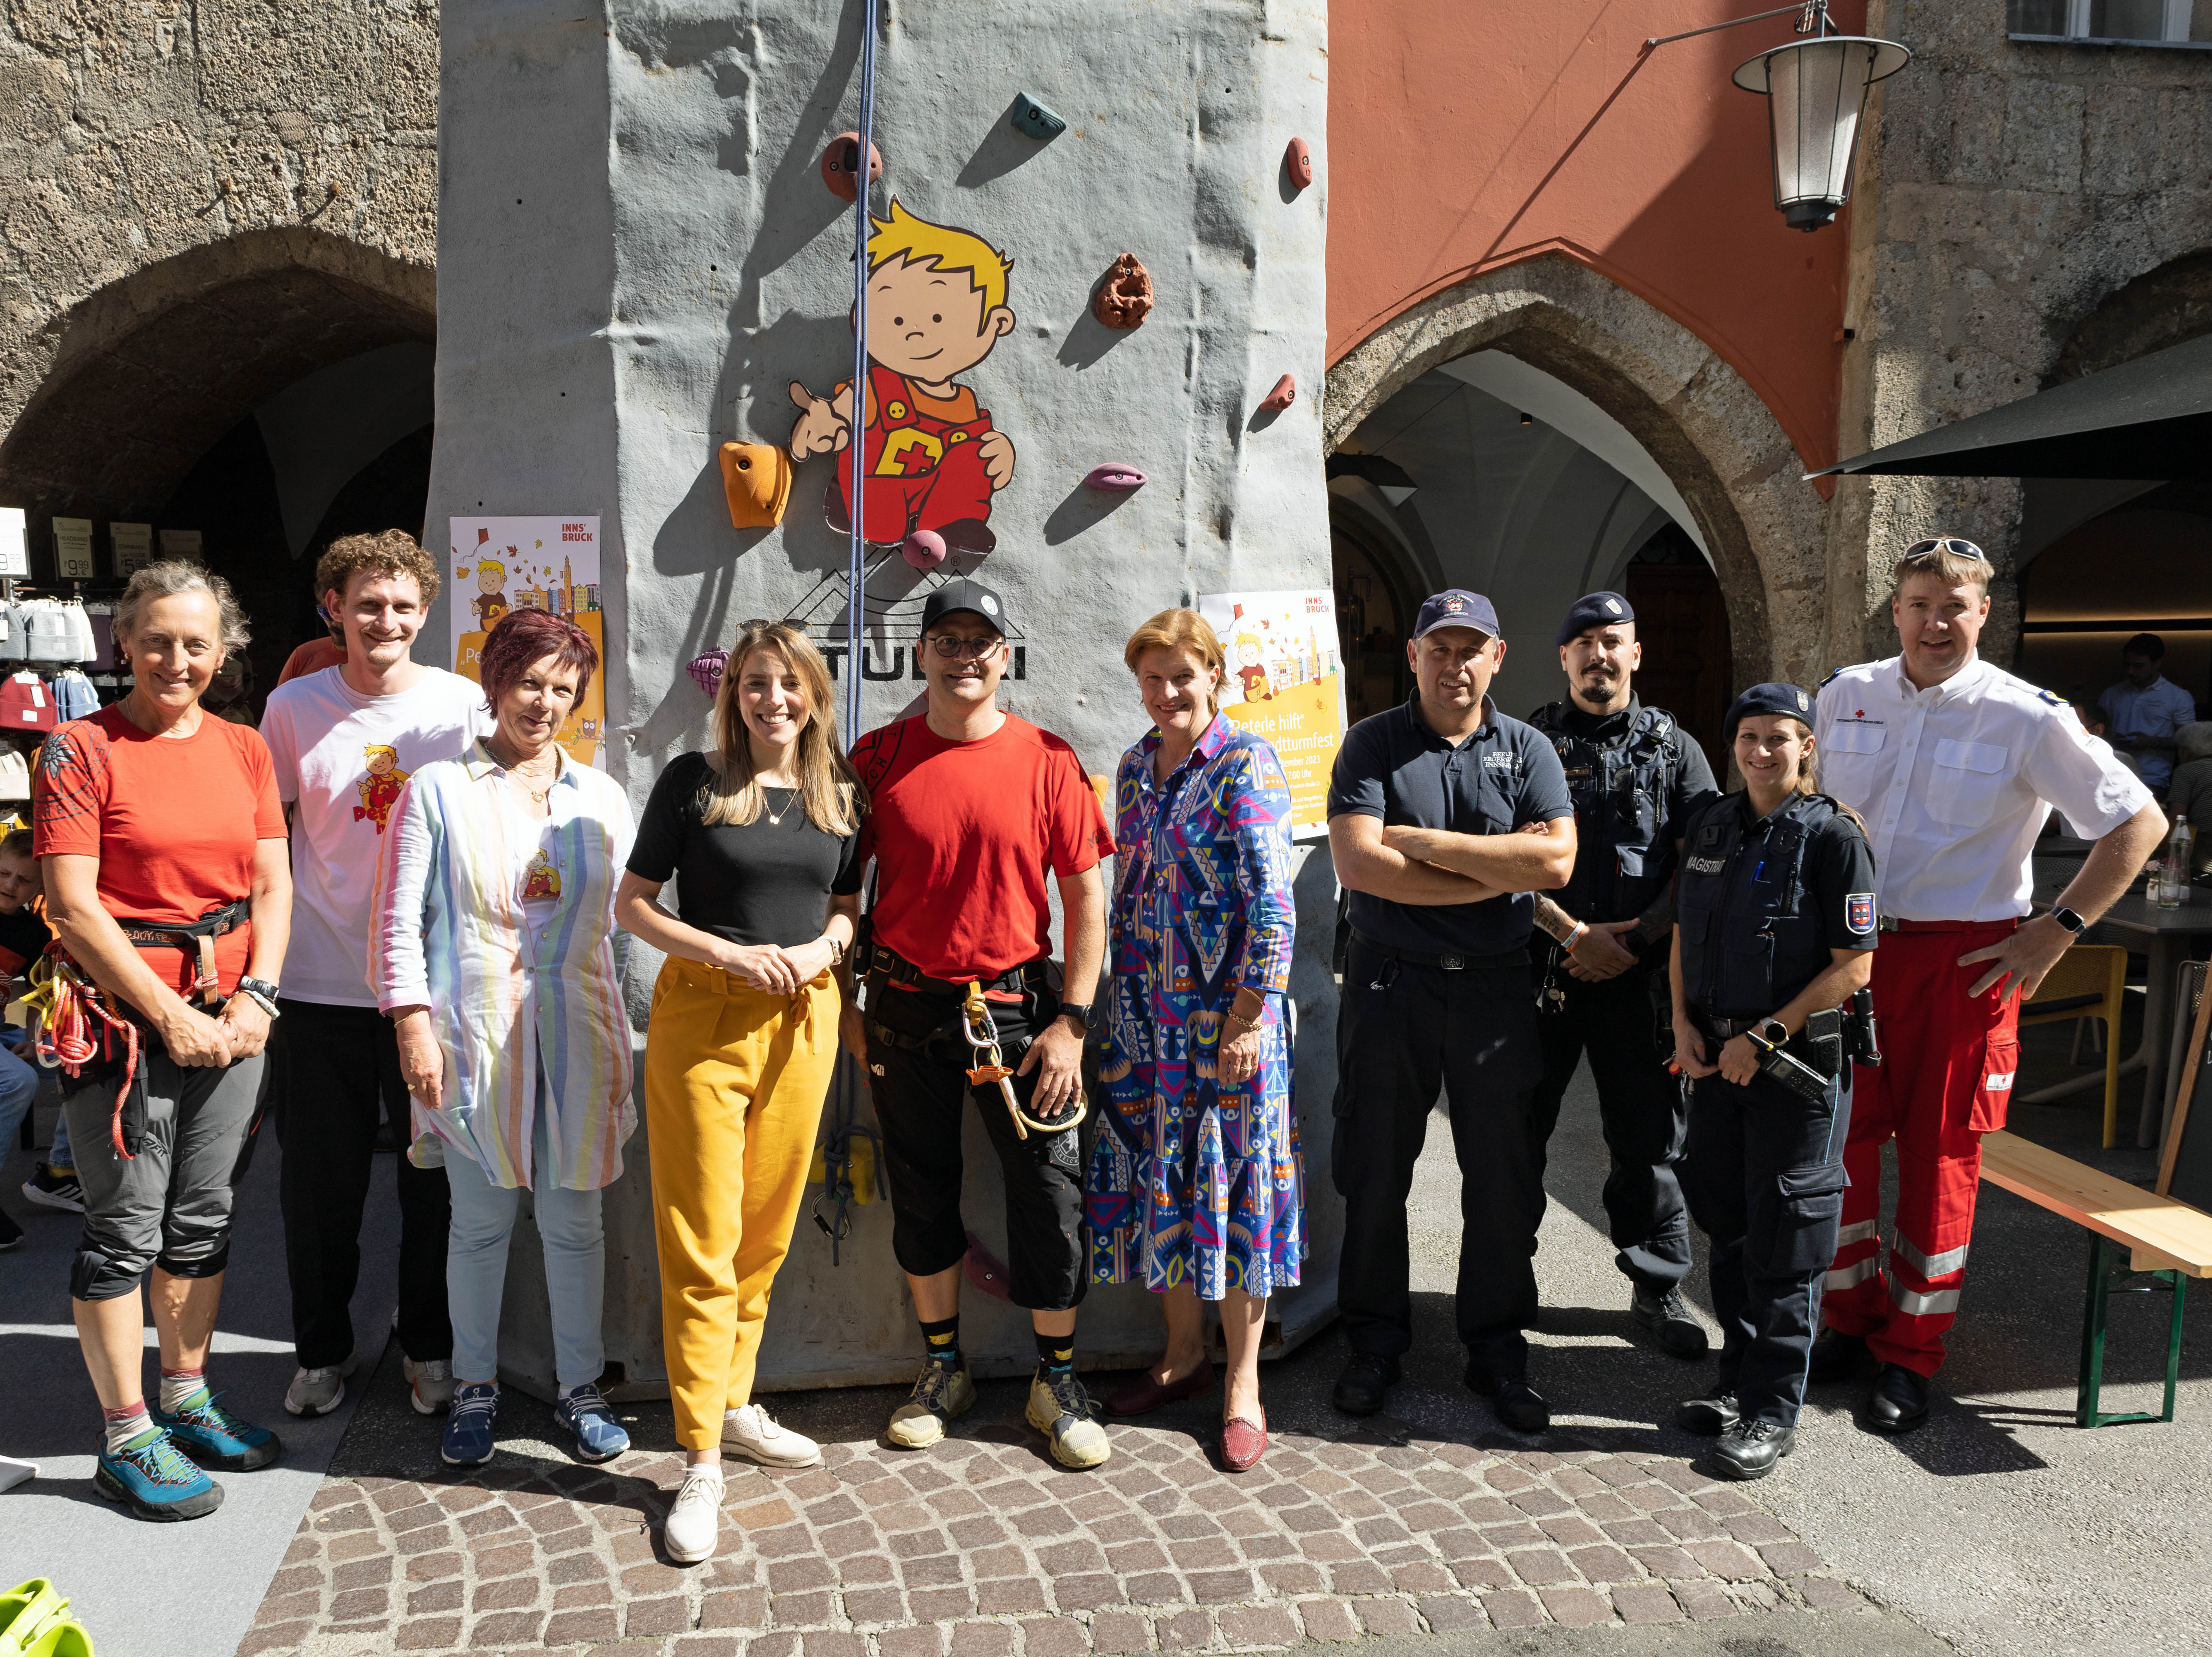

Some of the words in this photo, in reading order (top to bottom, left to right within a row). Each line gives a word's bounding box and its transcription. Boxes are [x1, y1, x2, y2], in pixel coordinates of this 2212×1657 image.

[562, 533, 593, 541] BRUCK
[1306, 605, 1329, 613] BRUCK
[1305, 755, 1321, 765] 2023
[1301, 769, 1313, 779] Uhr
[1686, 857, 1726, 873] MAGISTRAT
